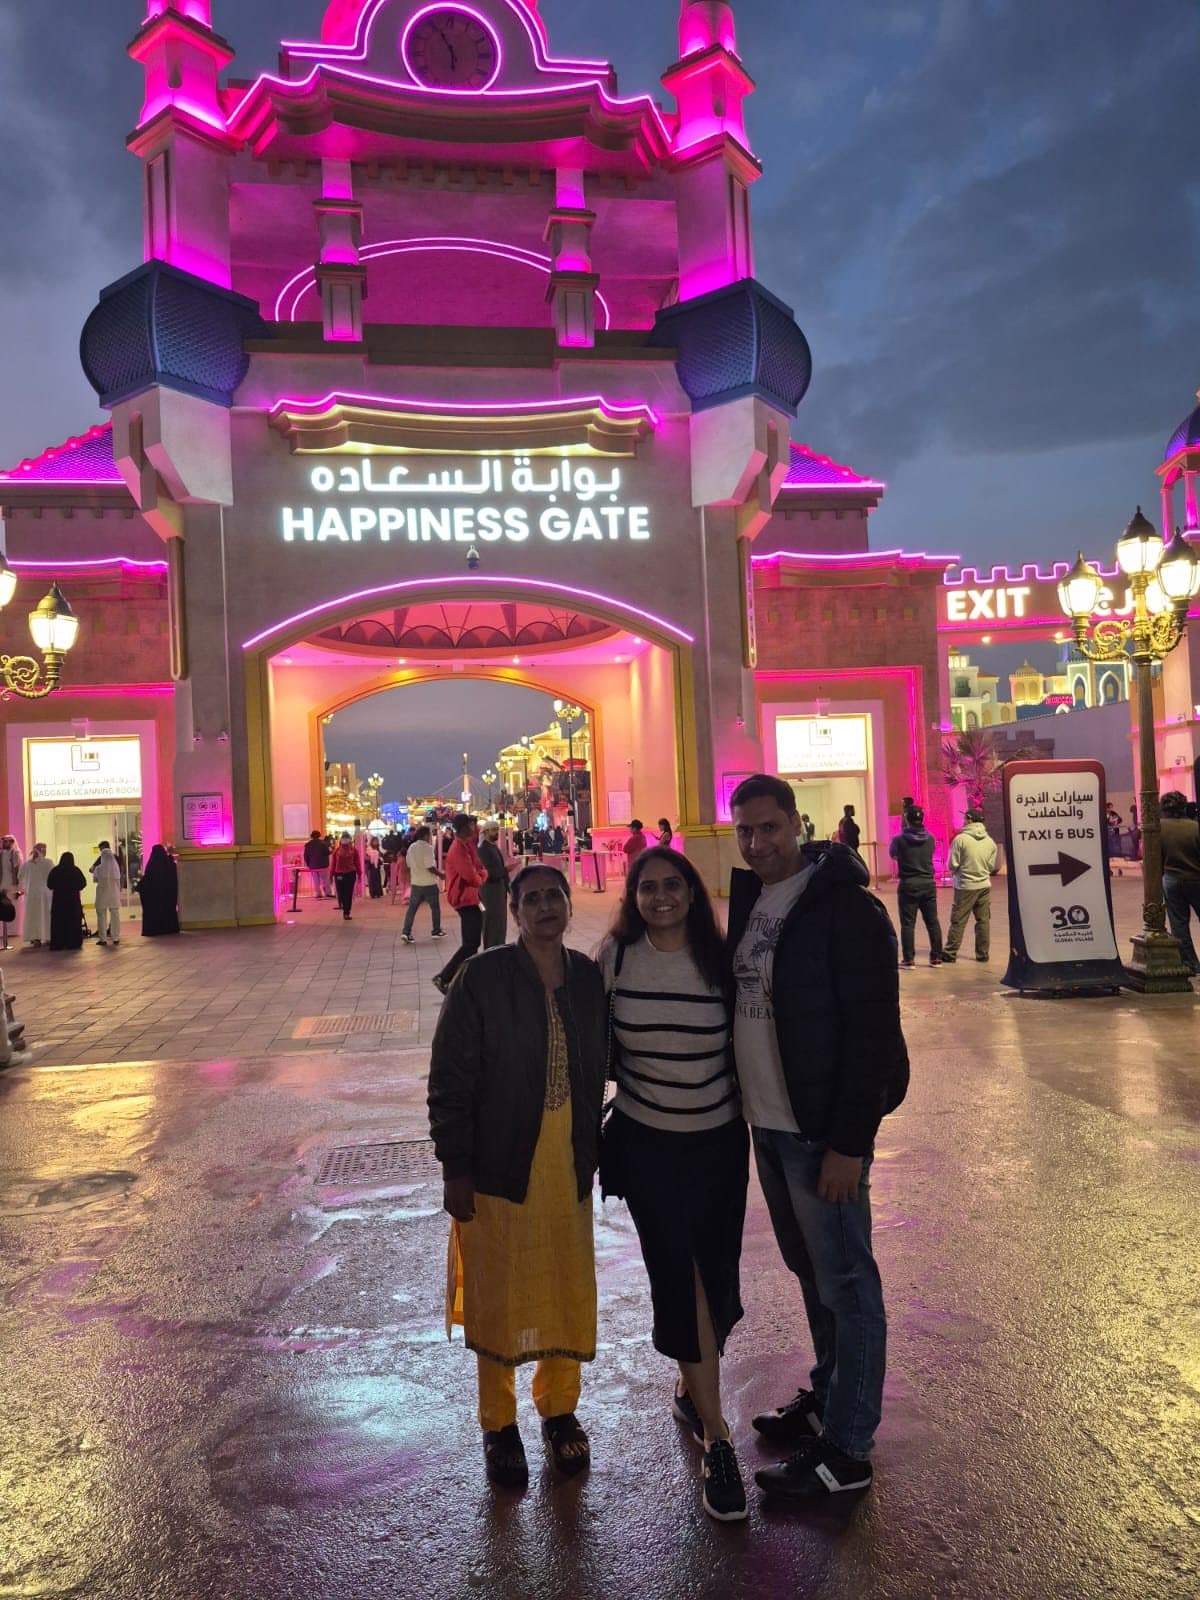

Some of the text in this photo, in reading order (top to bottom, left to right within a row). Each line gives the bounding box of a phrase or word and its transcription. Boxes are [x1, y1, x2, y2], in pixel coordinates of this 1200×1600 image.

[511, 457, 621, 502] بوابة
[281, 505, 651, 542] HAPPINESS GATE
[946, 586, 1031, 621] EXIT
[1053, 790, 1094, 804] سيارات
[1027, 805, 1084, 820] والحافلات
[1018, 828, 1095, 841] TAXI & BUS
[1050, 904, 1090, 929] 30
[749, 1006, 772, 1020] BEA
